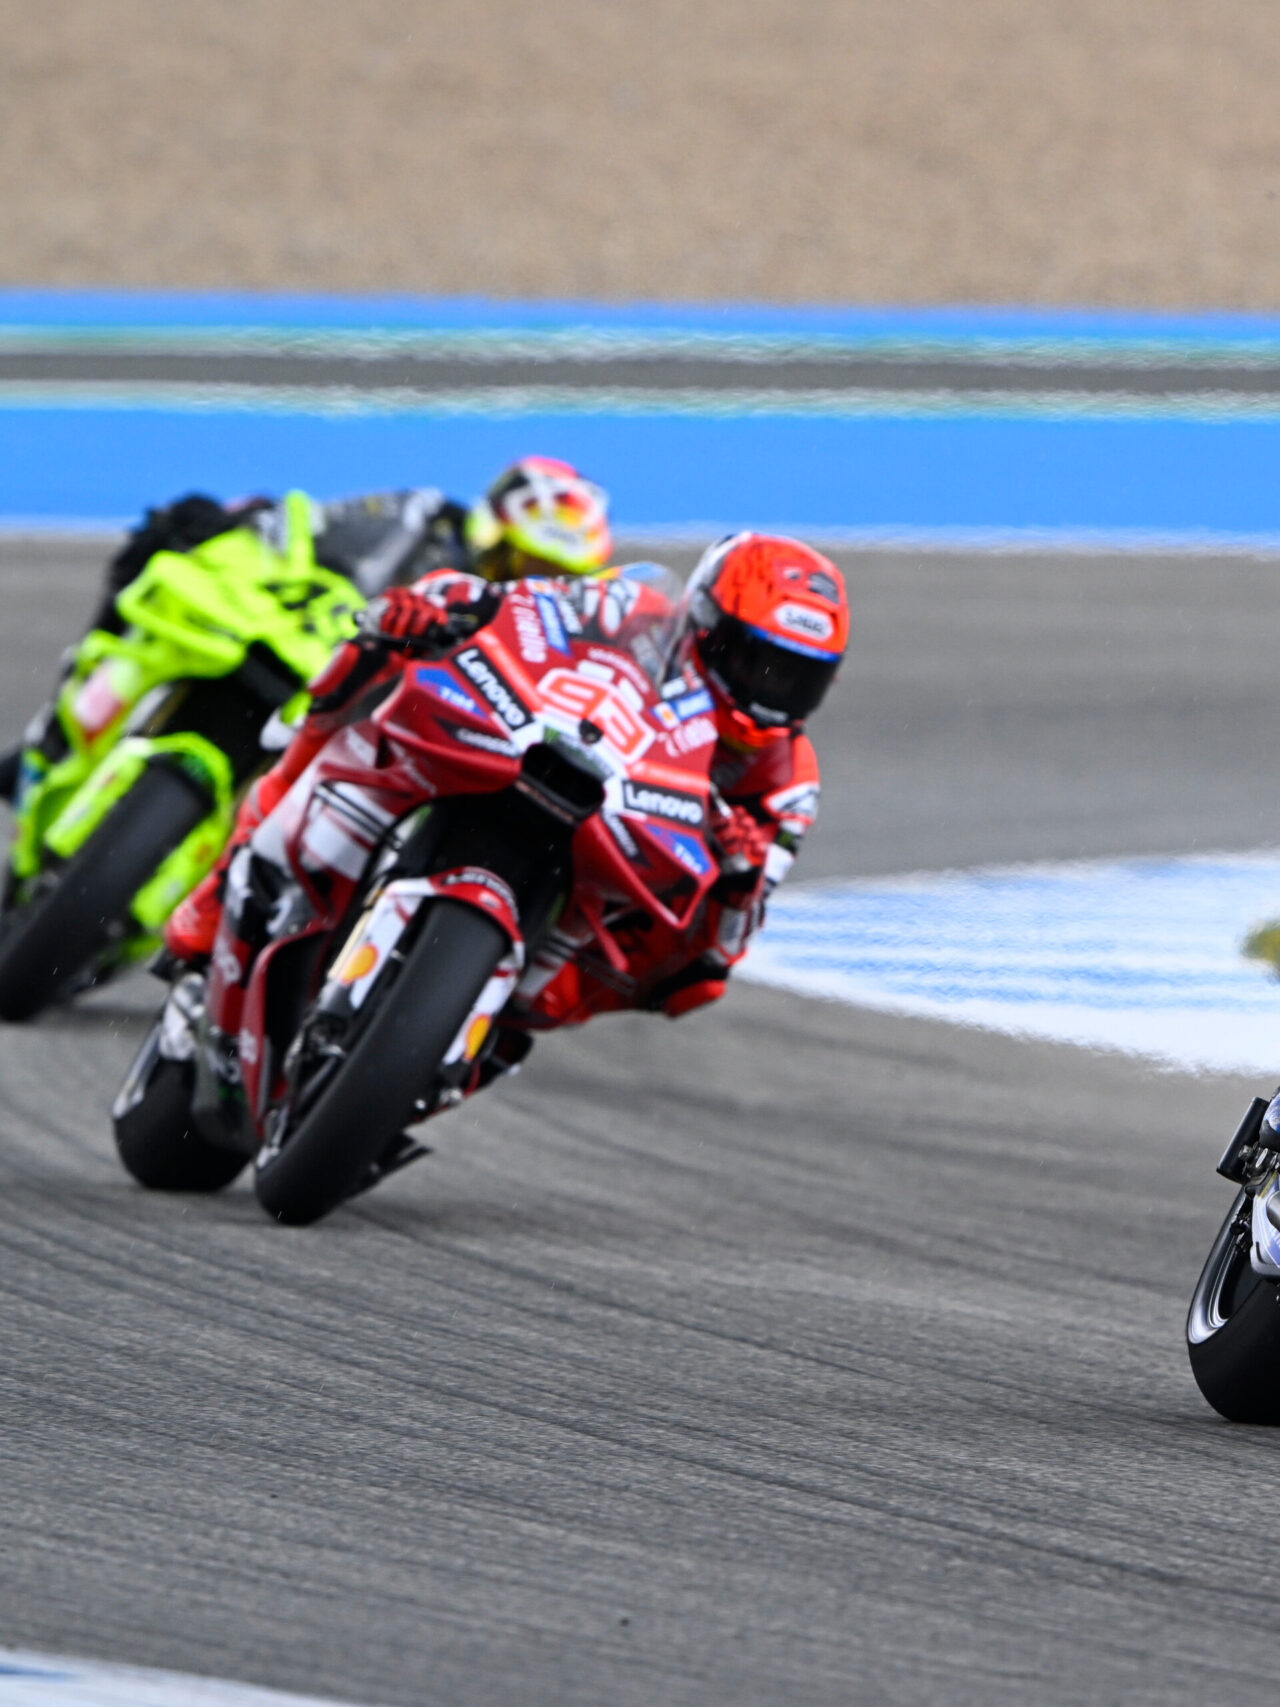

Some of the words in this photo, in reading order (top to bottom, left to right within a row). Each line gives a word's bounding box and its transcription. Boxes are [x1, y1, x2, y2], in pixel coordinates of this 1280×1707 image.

[456, 648, 525, 726] Lenovo
[536, 667, 656, 764] 93
[625, 783, 703, 824] Lenovo
